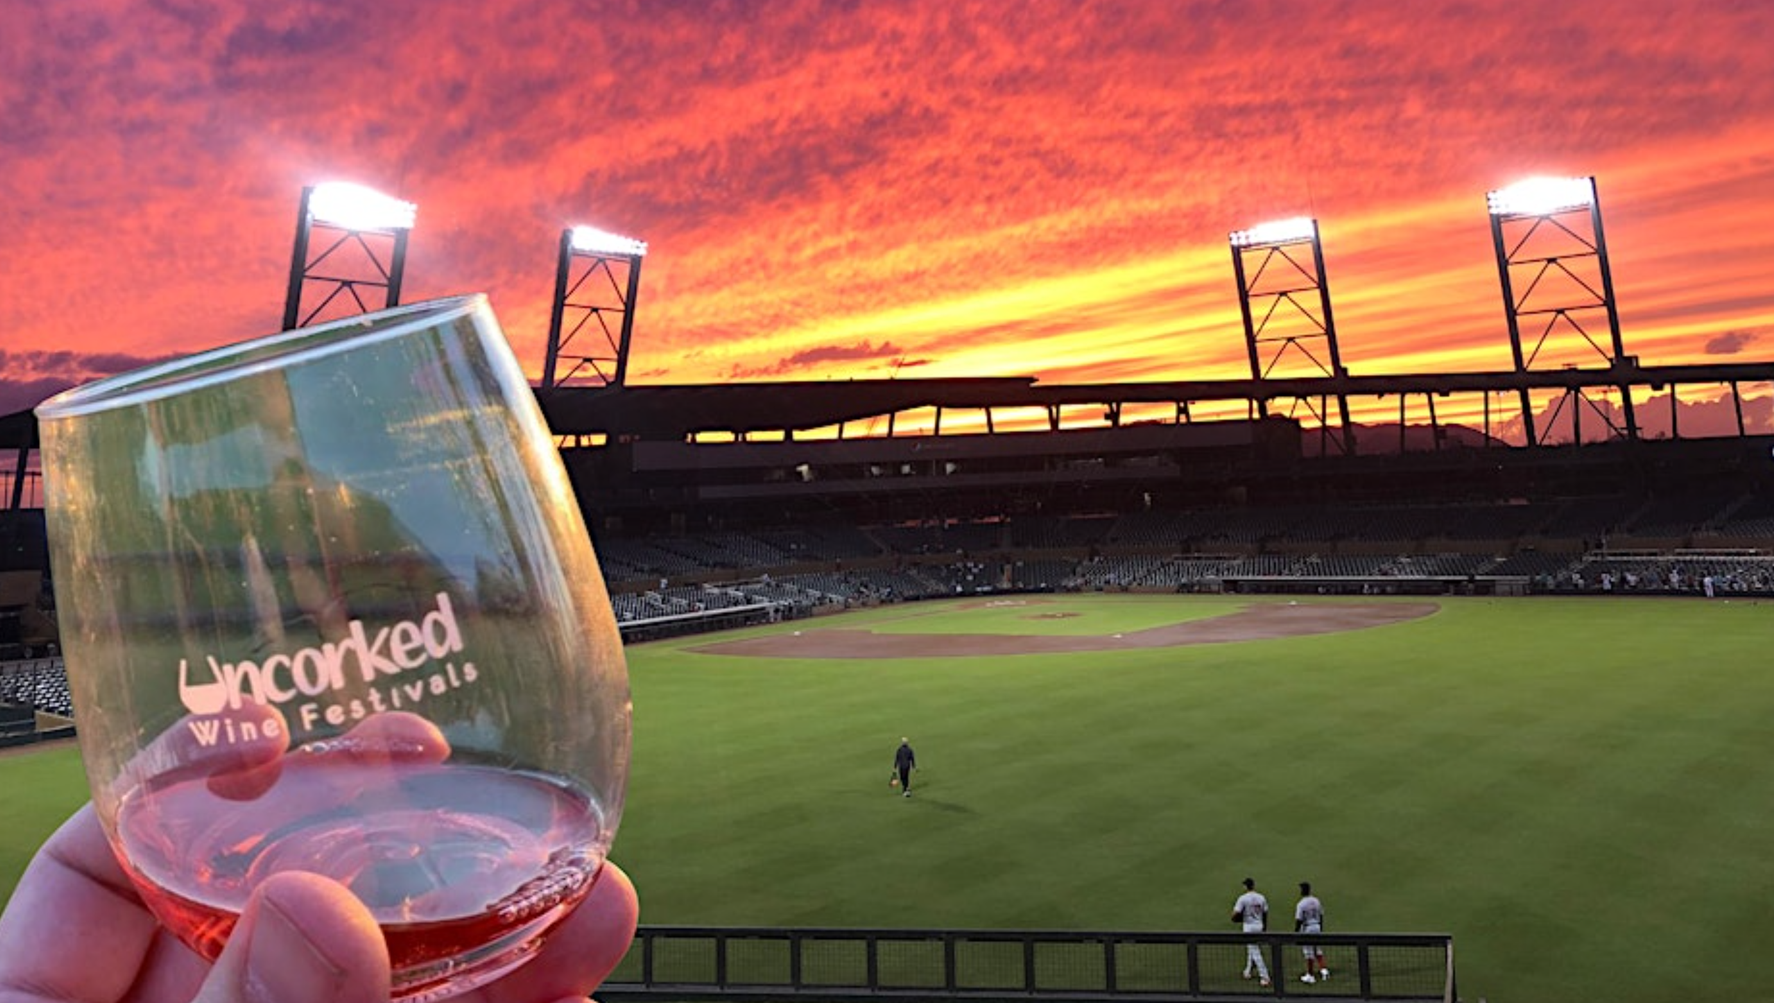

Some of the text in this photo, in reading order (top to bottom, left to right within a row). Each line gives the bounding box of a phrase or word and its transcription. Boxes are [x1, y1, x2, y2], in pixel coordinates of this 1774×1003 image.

[179, 591, 463, 715] Uncorked
[188, 661, 478, 748] Wine Festivals
